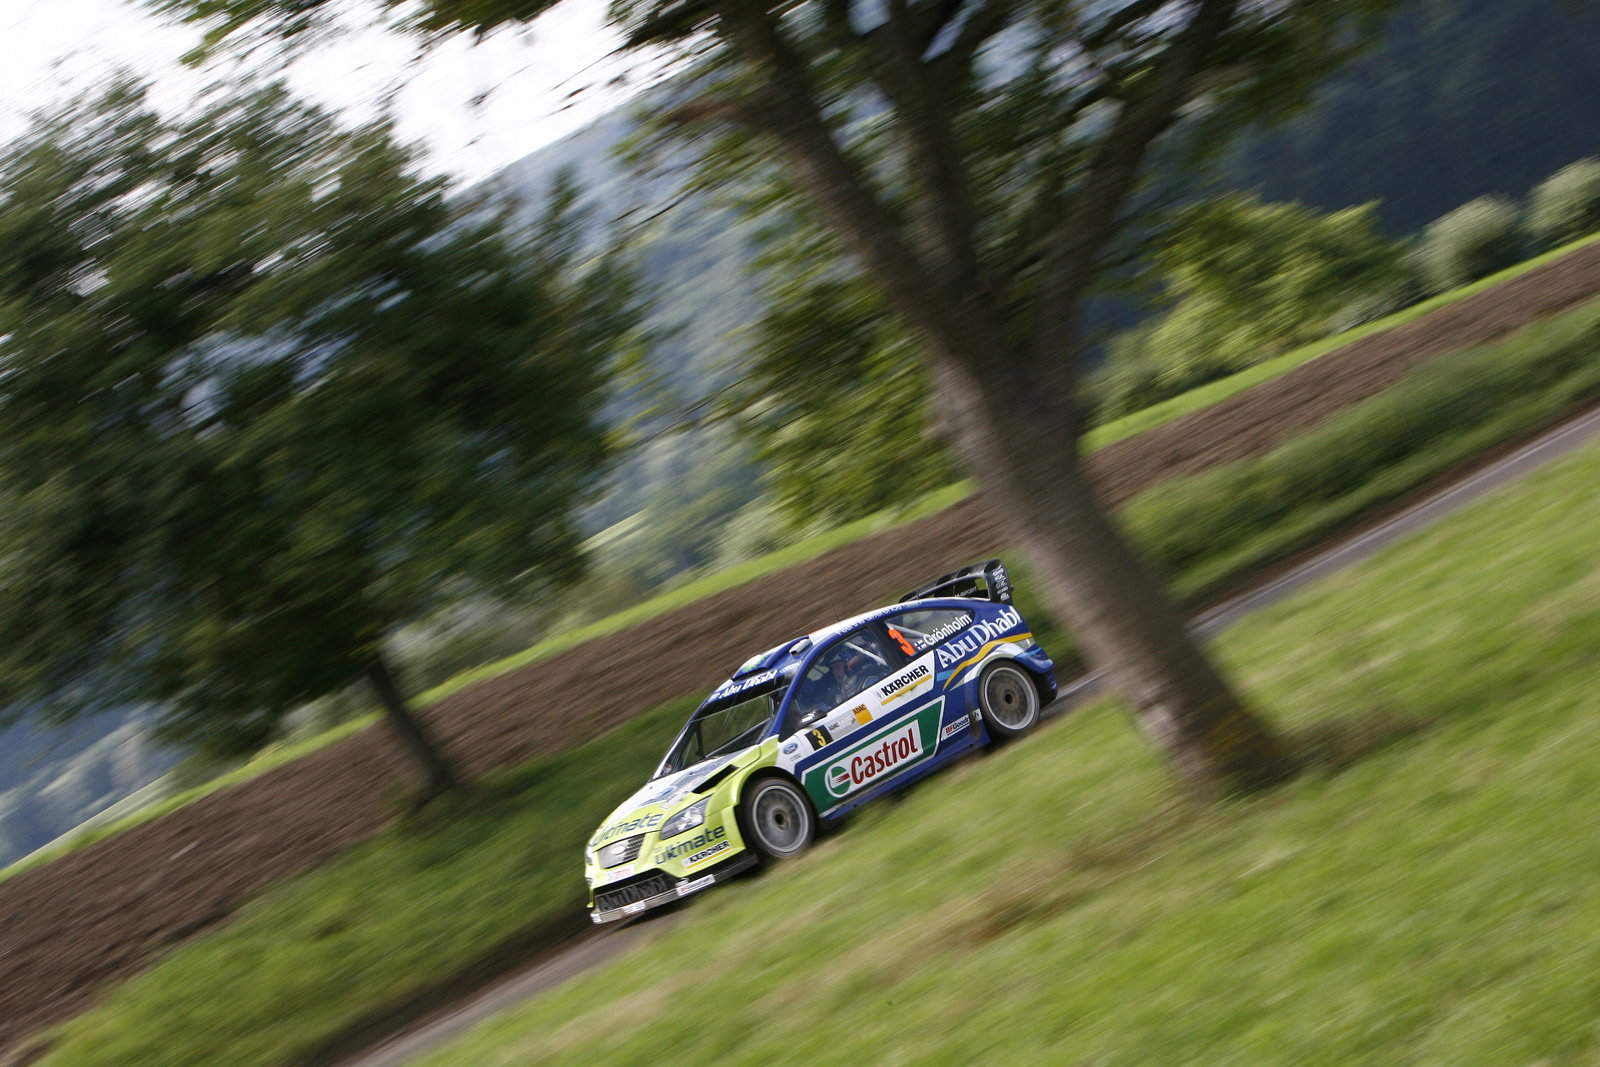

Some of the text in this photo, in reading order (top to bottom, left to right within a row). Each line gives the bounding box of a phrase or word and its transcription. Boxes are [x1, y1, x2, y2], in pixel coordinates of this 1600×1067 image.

[888, 627, 915, 656] 3
[922, 613, 973, 646] Grönholm
[935, 605, 1023, 669] Abu Dhabi
[881, 664, 929, 697] KÄRCHER
[852, 704, 867, 715] ADAC
[812, 729, 828, 747] 3
[851, 728, 918, 785] Castrol
[655, 825, 726, 865] ultimate
